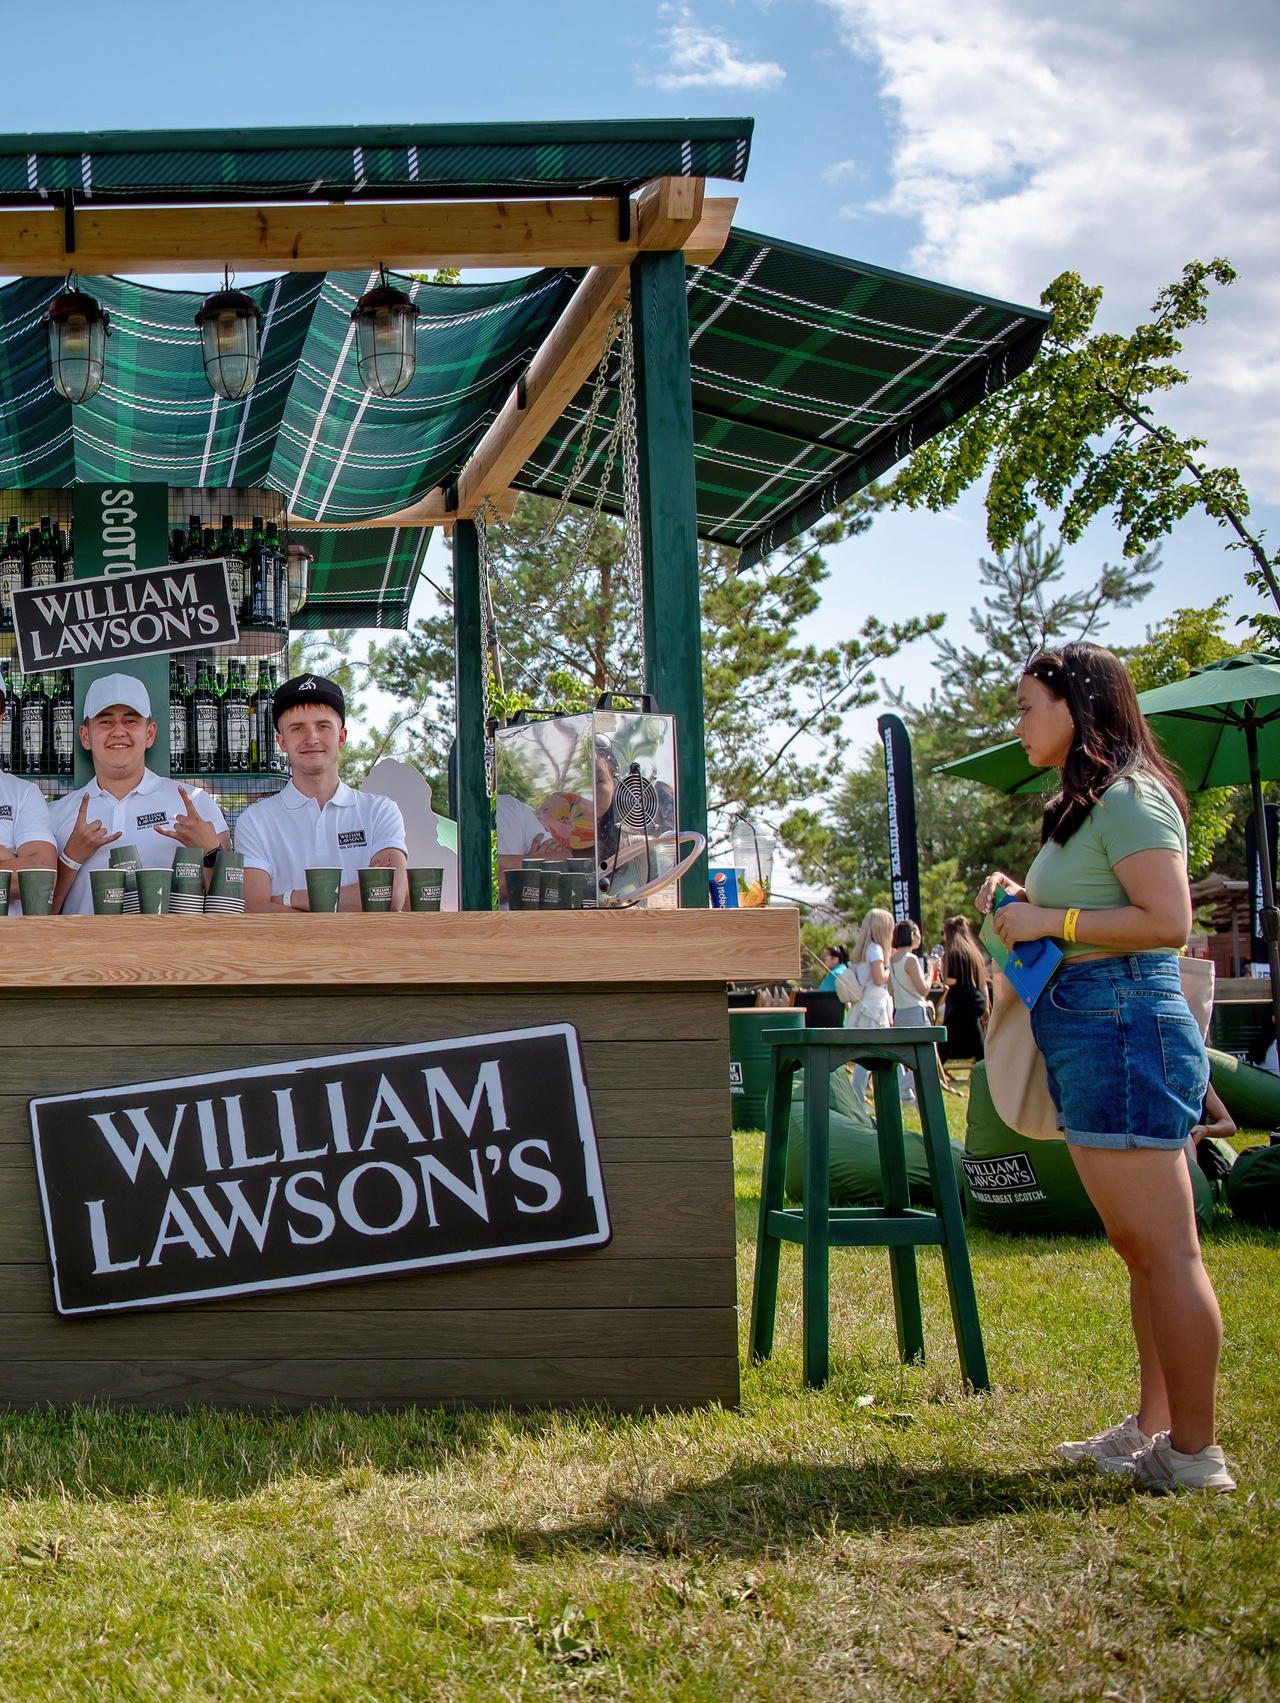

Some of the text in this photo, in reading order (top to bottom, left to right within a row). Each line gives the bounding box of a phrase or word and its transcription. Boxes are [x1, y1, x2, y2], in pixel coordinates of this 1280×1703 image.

[31, 573, 199, 626] WILLIAM
[30, 604, 220, 661] LAWSON'S
[88, 1059, 510, 1185] WILLIAM
[964, 1159, 1020, 1176] WILLIAM
[967, 1170, 1031, 1187] LAWSON'S
[83, 1139, 563, 1275] LAWSON'S
[1014, 1190, 1047, 1203] SCOTCH.
